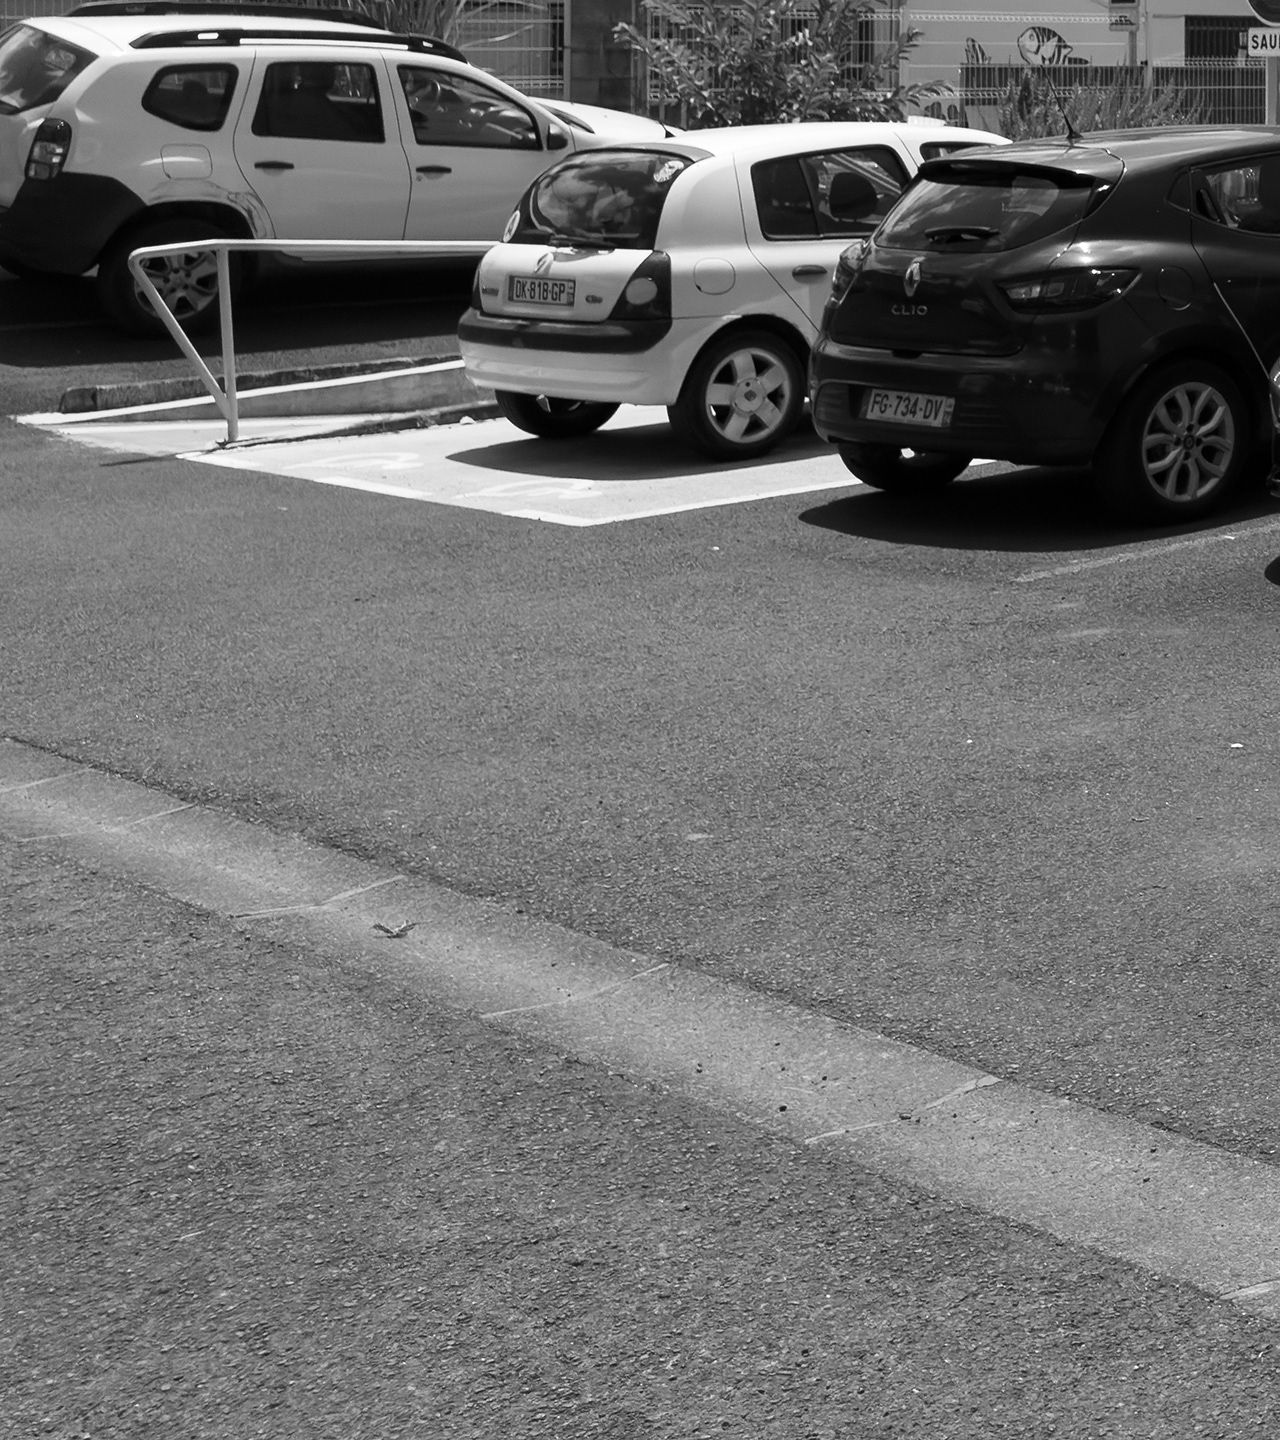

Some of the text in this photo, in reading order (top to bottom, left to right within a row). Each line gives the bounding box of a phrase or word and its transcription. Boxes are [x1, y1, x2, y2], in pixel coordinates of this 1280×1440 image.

[514, 279, 566, 302] DK-818-GP
[891, 303, 928, 316] CLIO
[870, 392, 944, 421] FG-734-DV
